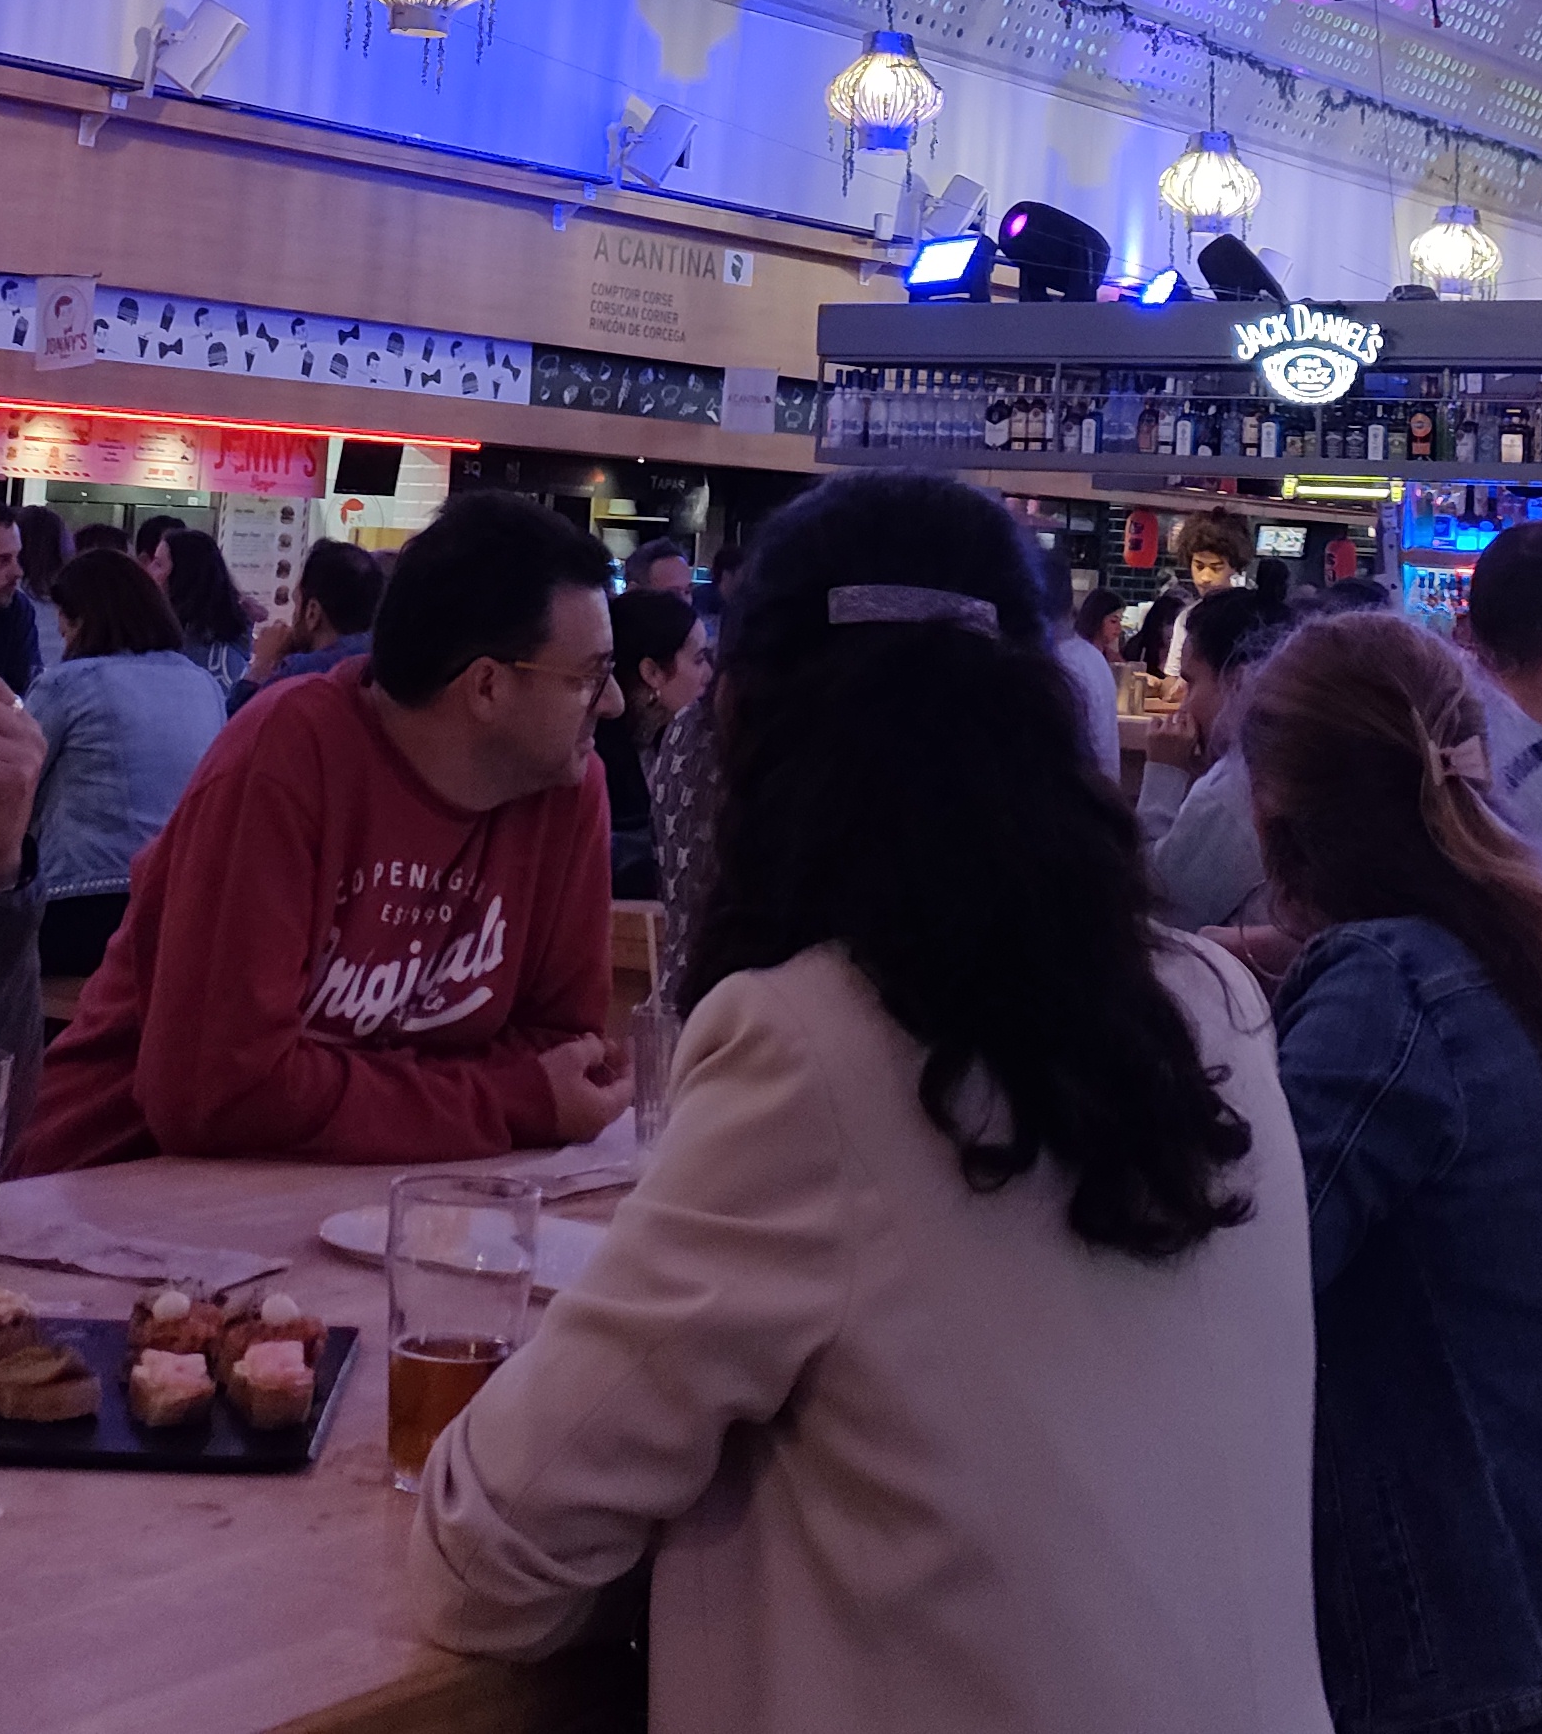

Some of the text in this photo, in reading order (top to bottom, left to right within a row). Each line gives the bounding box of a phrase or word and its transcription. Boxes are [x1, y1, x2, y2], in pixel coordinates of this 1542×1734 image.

[594, 231, 717, 280] A CANTINA
[590, 281, 674, 307] COMPTOIR CORSE
[589, 299, 679, 326] CORSICAN CORNER
[628, 322, 641, 337] DE
[1234, 303, 1384, 364] JACK DANIEL'S
